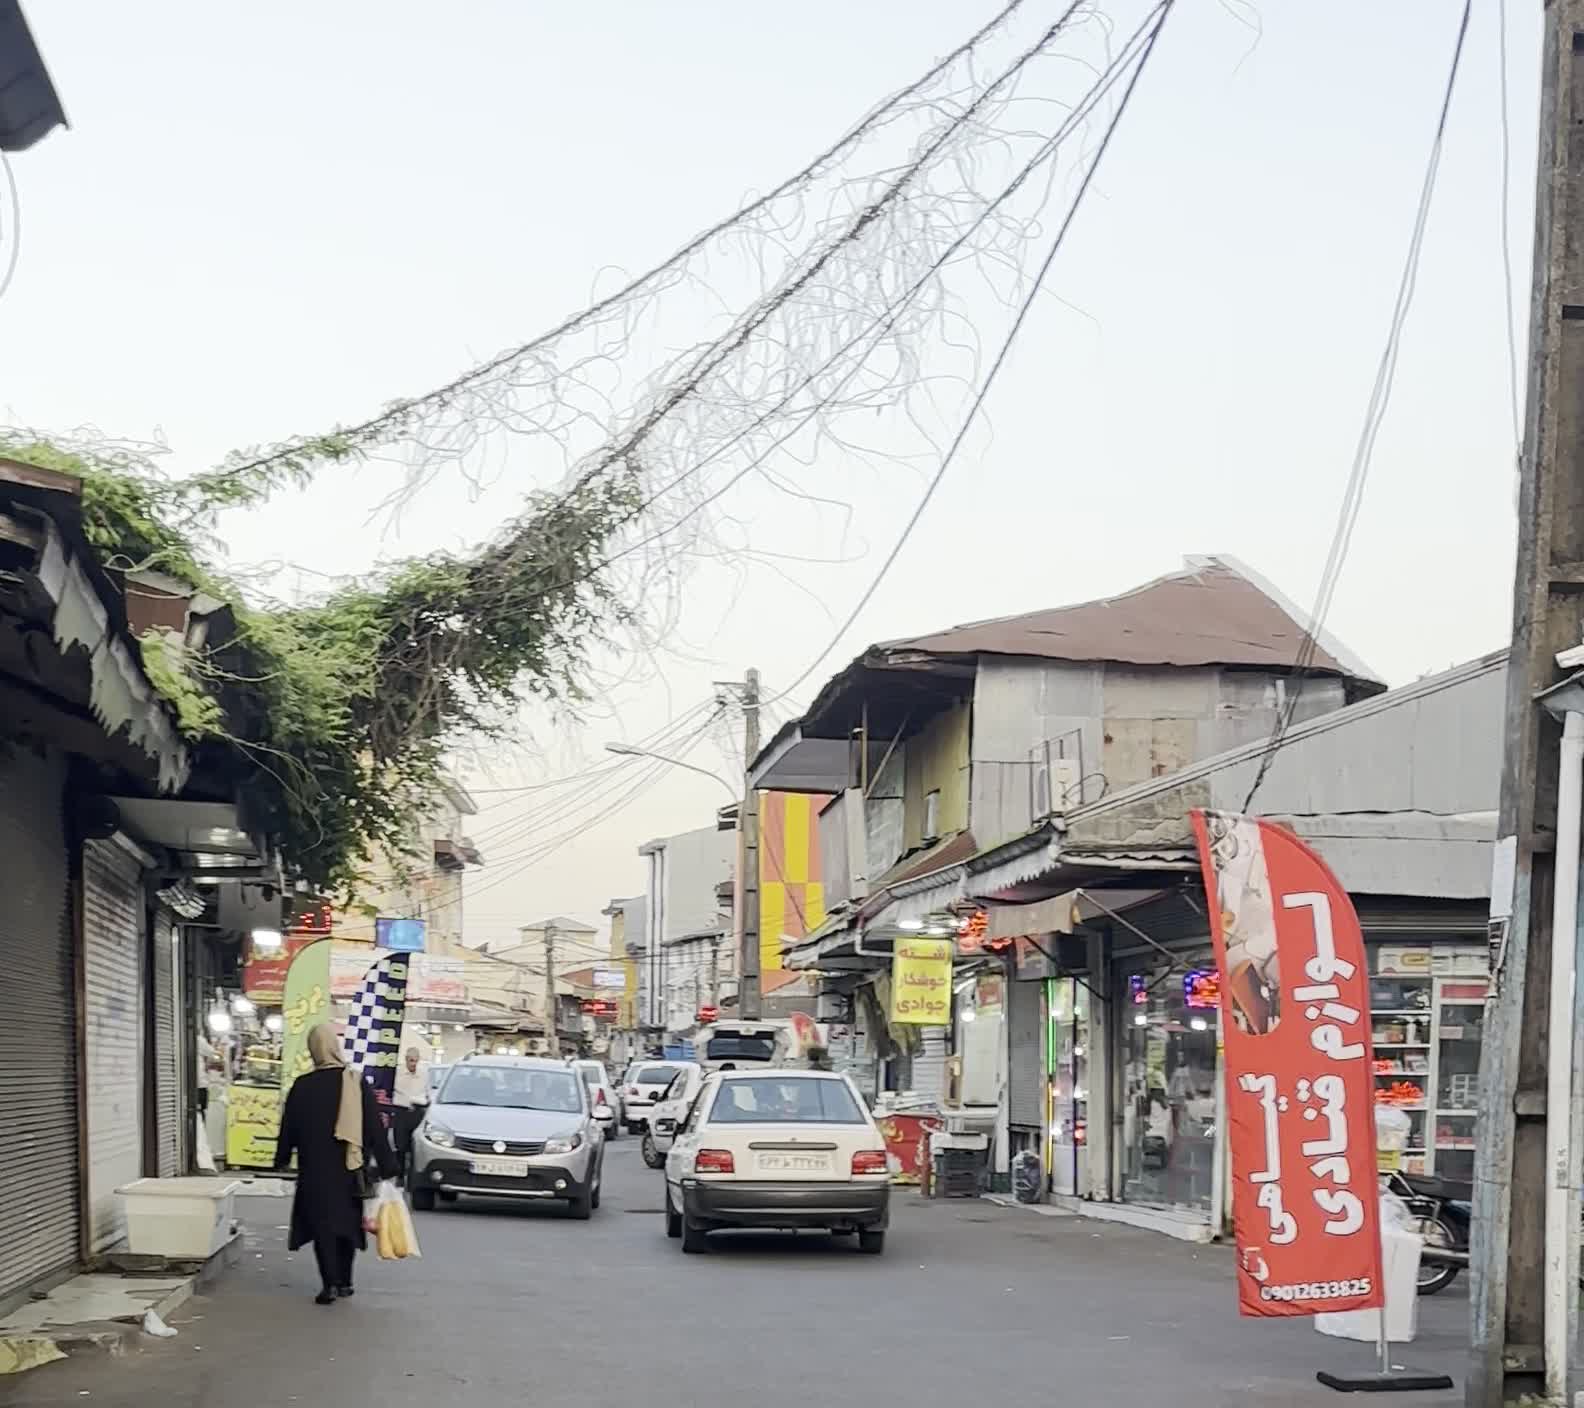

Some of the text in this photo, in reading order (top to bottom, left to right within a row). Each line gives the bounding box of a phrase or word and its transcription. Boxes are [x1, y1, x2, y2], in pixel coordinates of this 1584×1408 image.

[376, 962, 408, 1068] SPEED
[896, 996, 945, 1017] جوادی
[1282, 891, 1365, 1236] لوازم قنادی
[1238, 1072, 1296, 1244] گیاهی
[1260, 1278, 1371, 1301] 09012633825
